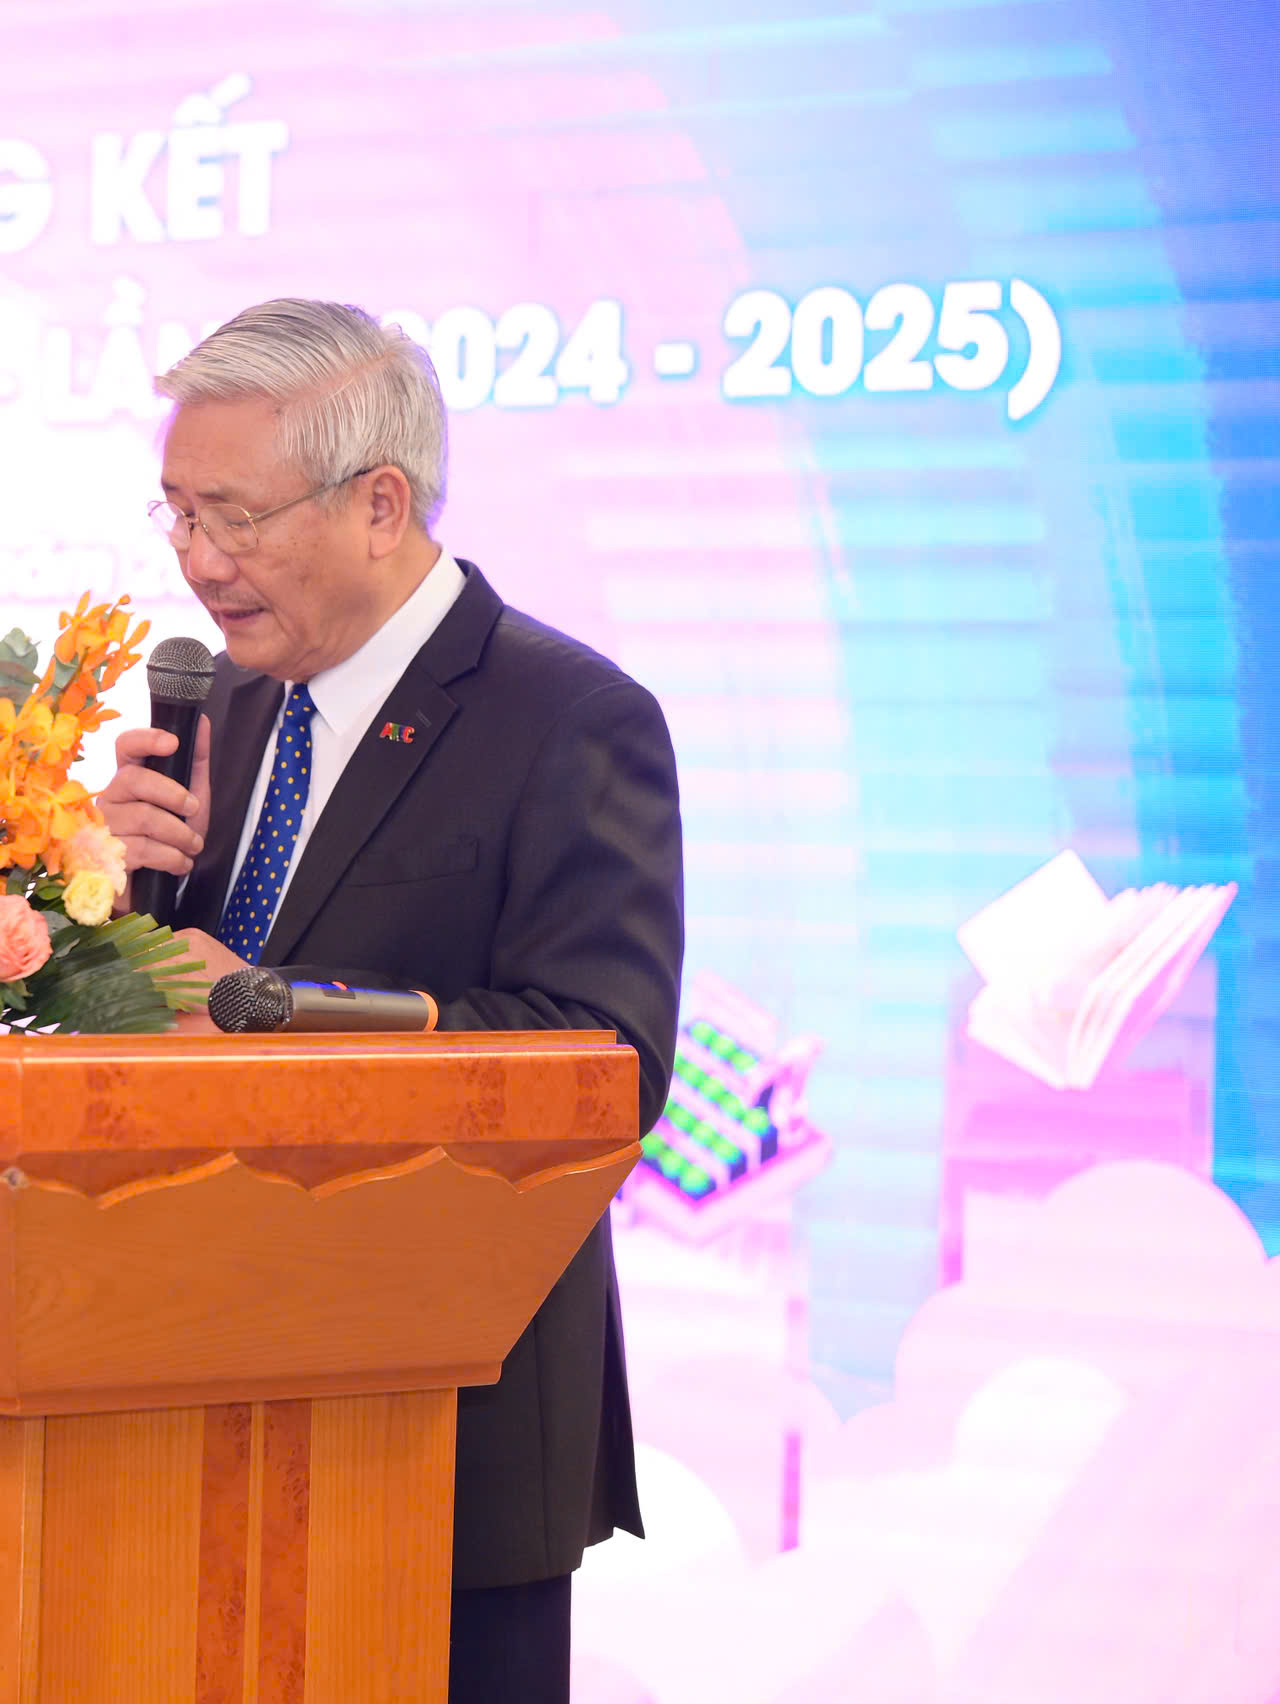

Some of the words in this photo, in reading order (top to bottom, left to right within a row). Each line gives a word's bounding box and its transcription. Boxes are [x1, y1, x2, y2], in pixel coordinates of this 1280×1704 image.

[89, 73, 288, 246] KẾT
[378, 298, 629, 410] 024
[722, 278, 1061, 421] 2025)
